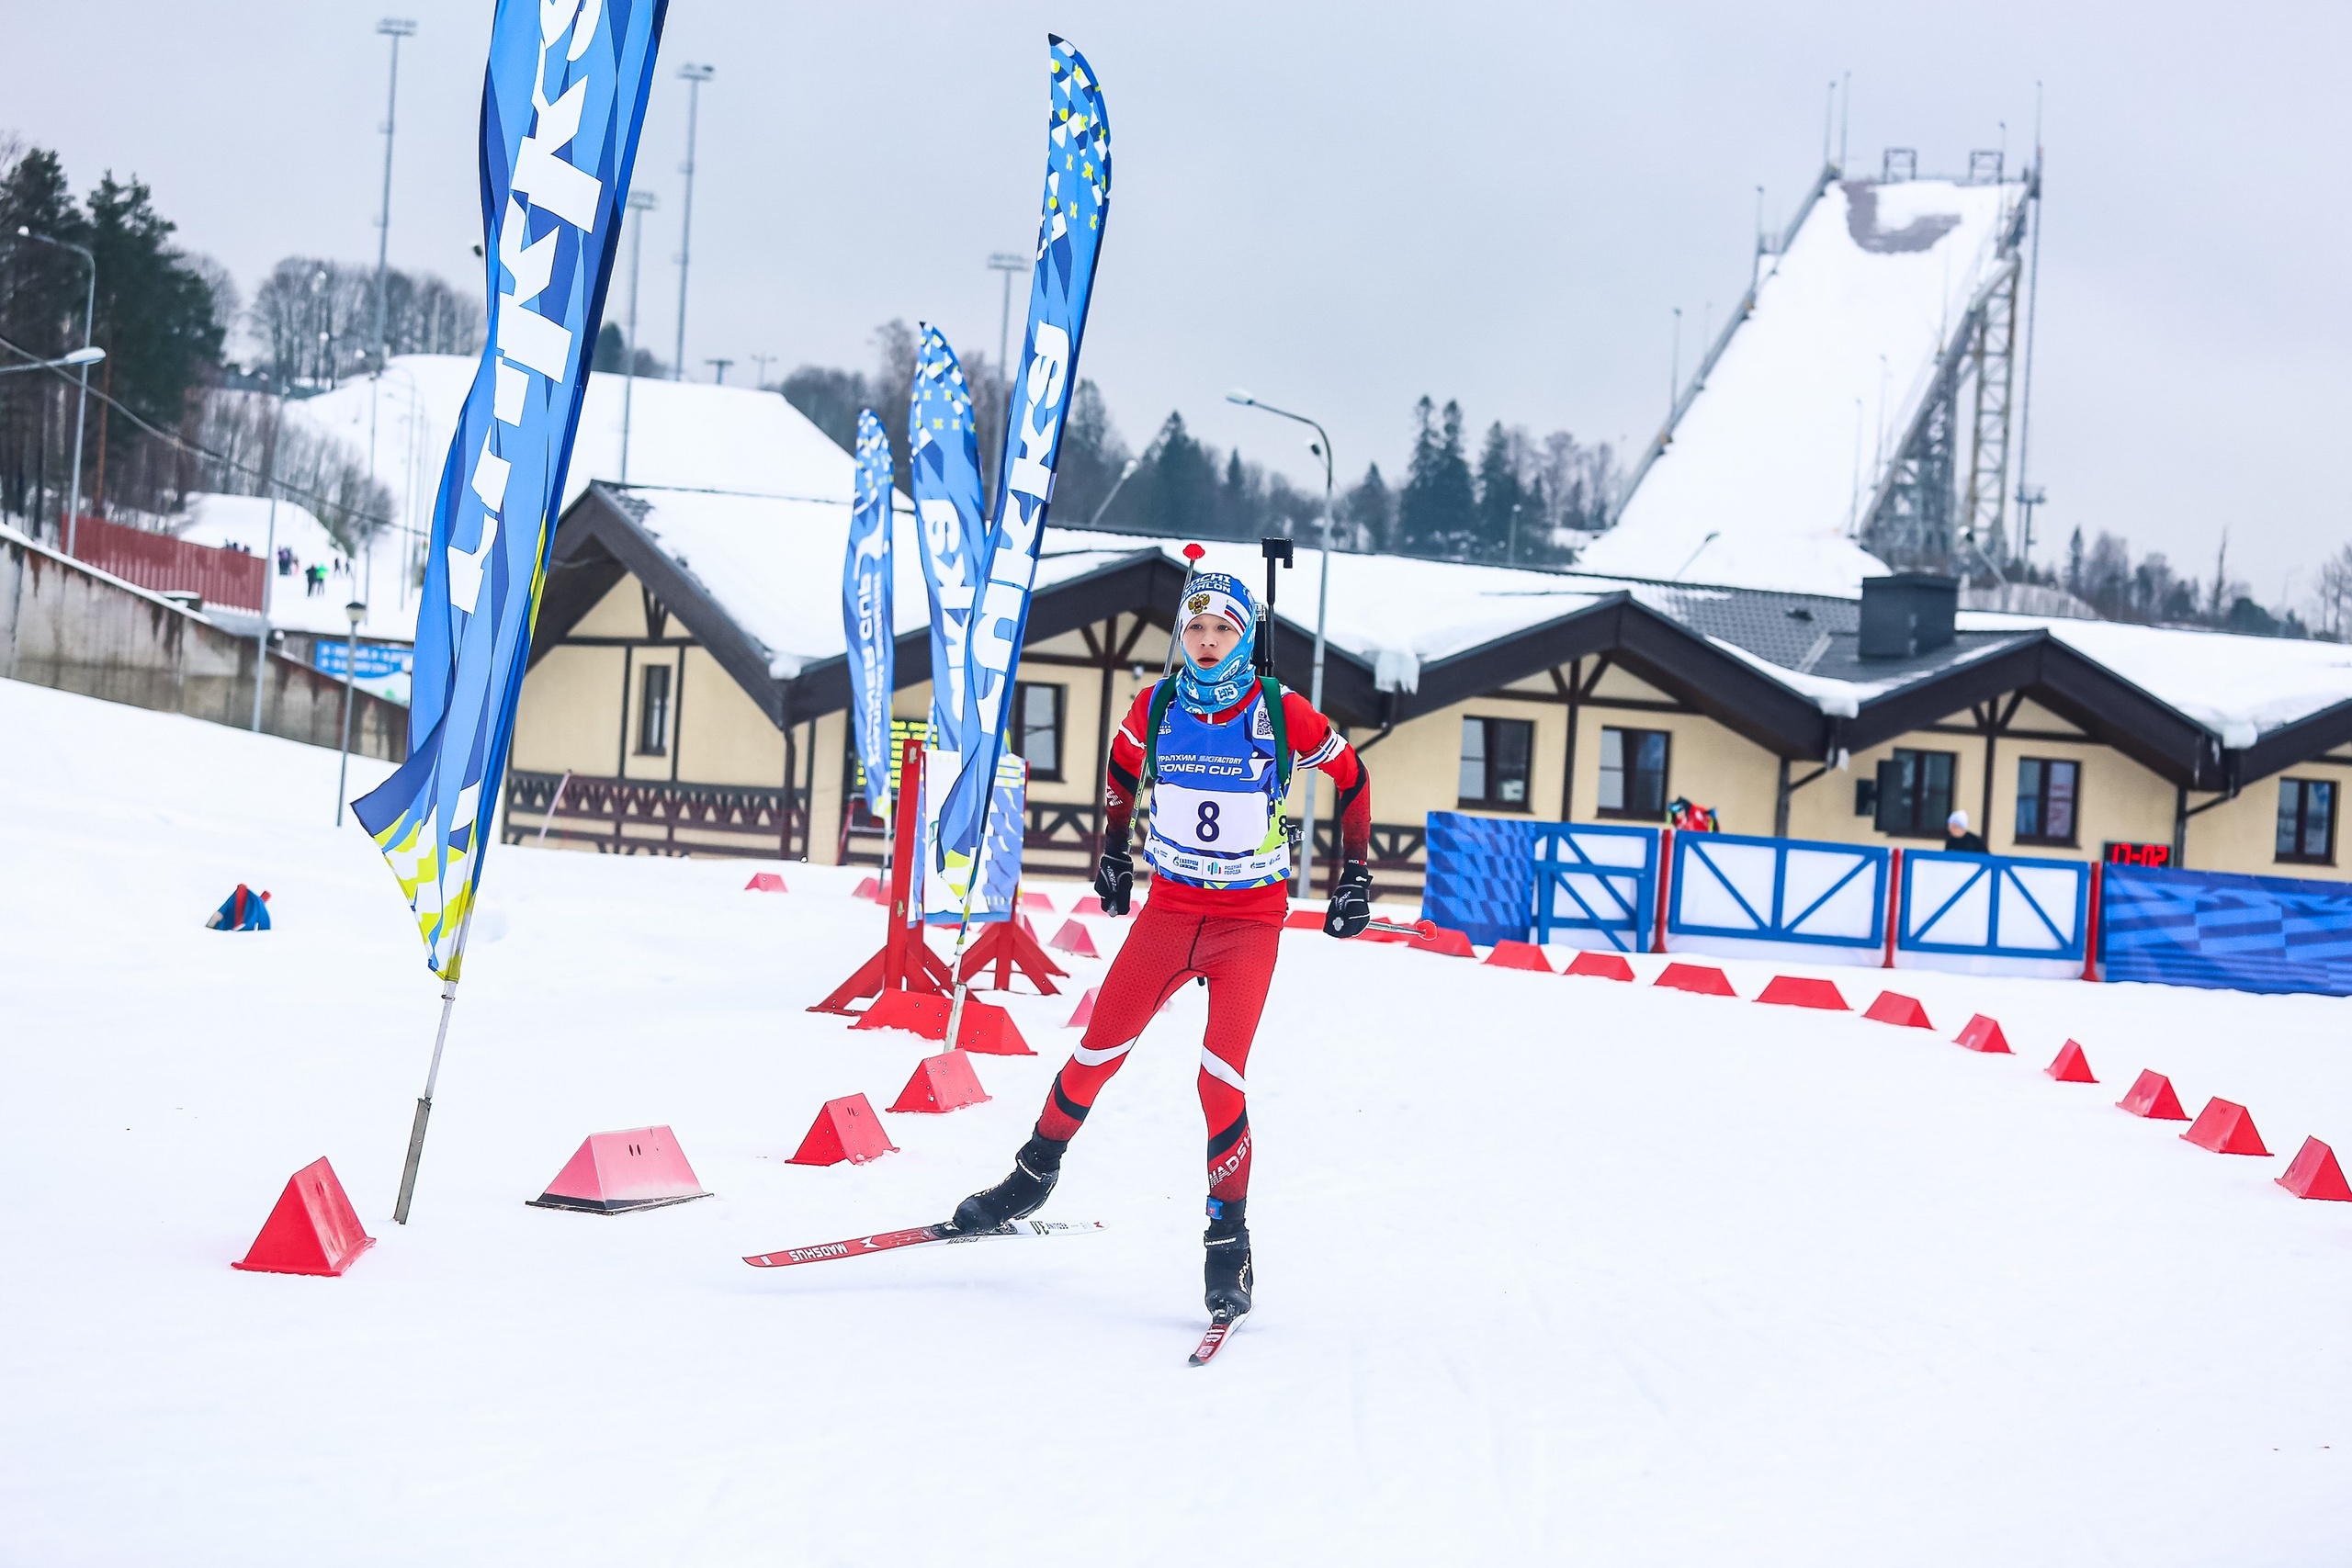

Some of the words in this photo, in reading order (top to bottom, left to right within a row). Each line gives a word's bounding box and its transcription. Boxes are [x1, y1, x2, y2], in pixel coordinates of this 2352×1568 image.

[1158, 754, 1196, 762] УРАЛХИМ
[1208, 765, 1243, 776] CUP
[1196, 801, 1220, 842] 8
[788, 1242, 849, 1262] MADSHUS
